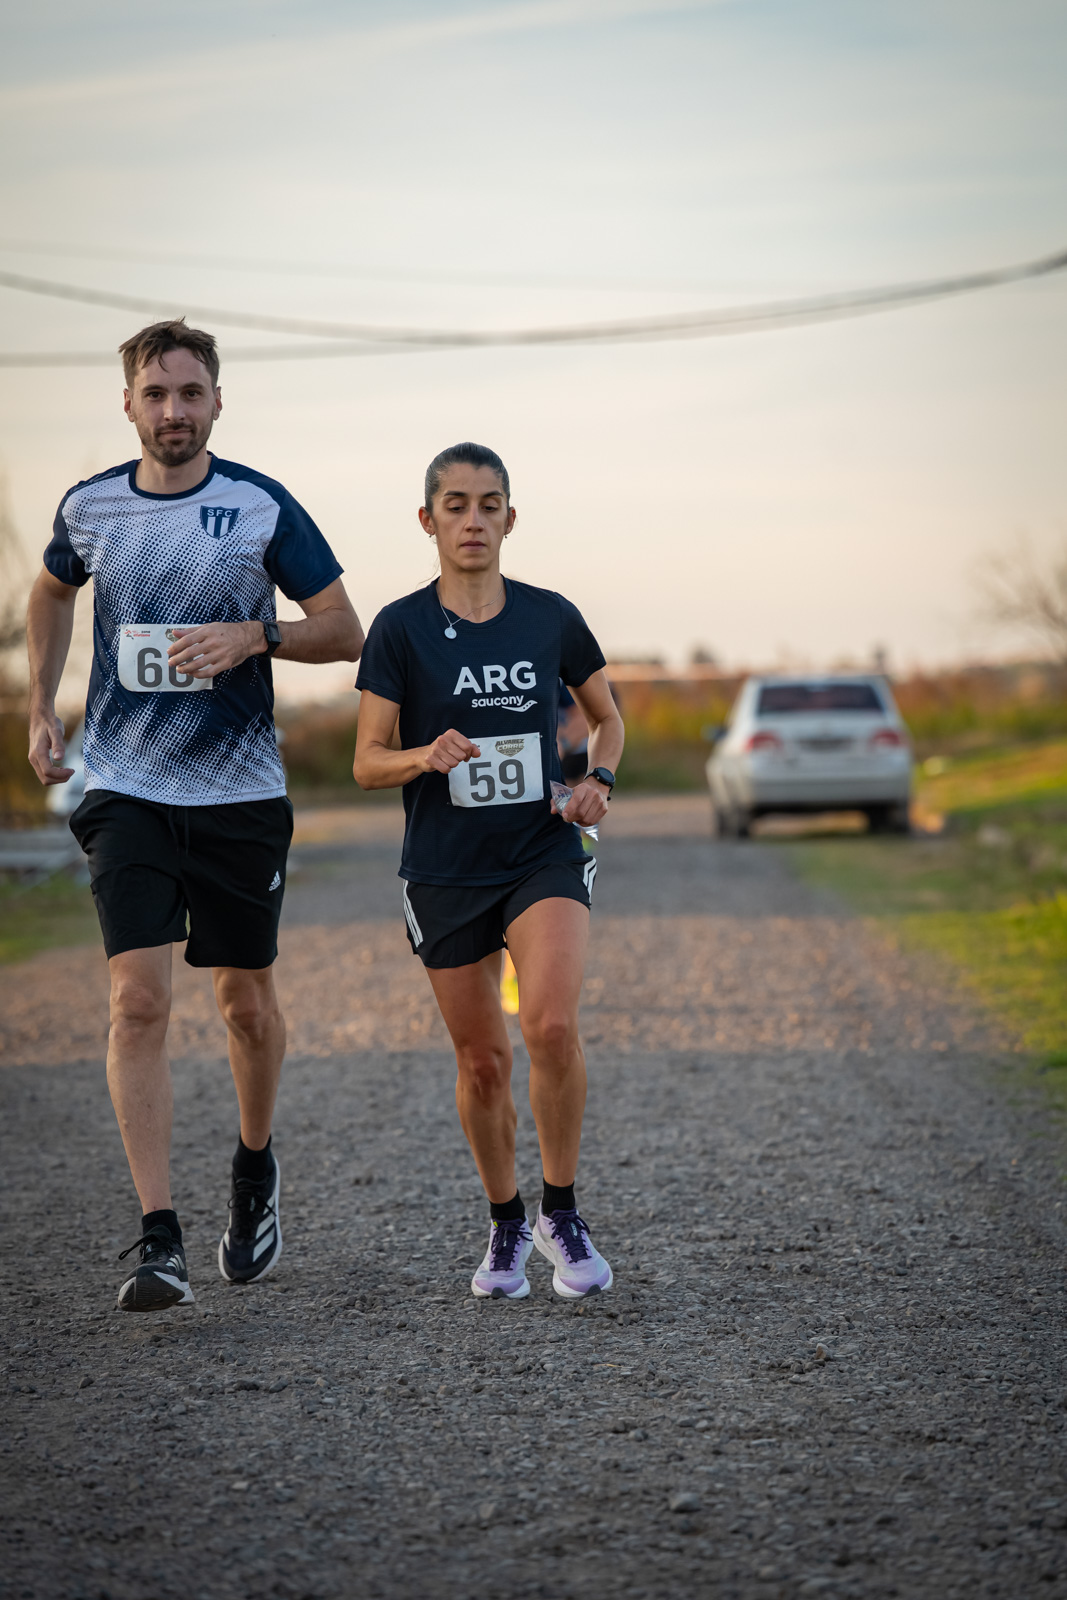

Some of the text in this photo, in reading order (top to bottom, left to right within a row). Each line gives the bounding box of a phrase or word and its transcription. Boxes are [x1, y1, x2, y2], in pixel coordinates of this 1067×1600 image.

[207, 509, 233, 517] SFC
[453, 661, 537, 695] ARG
[471, 695, 524, 708] saucony
[469, 759, 525, 802] 59
